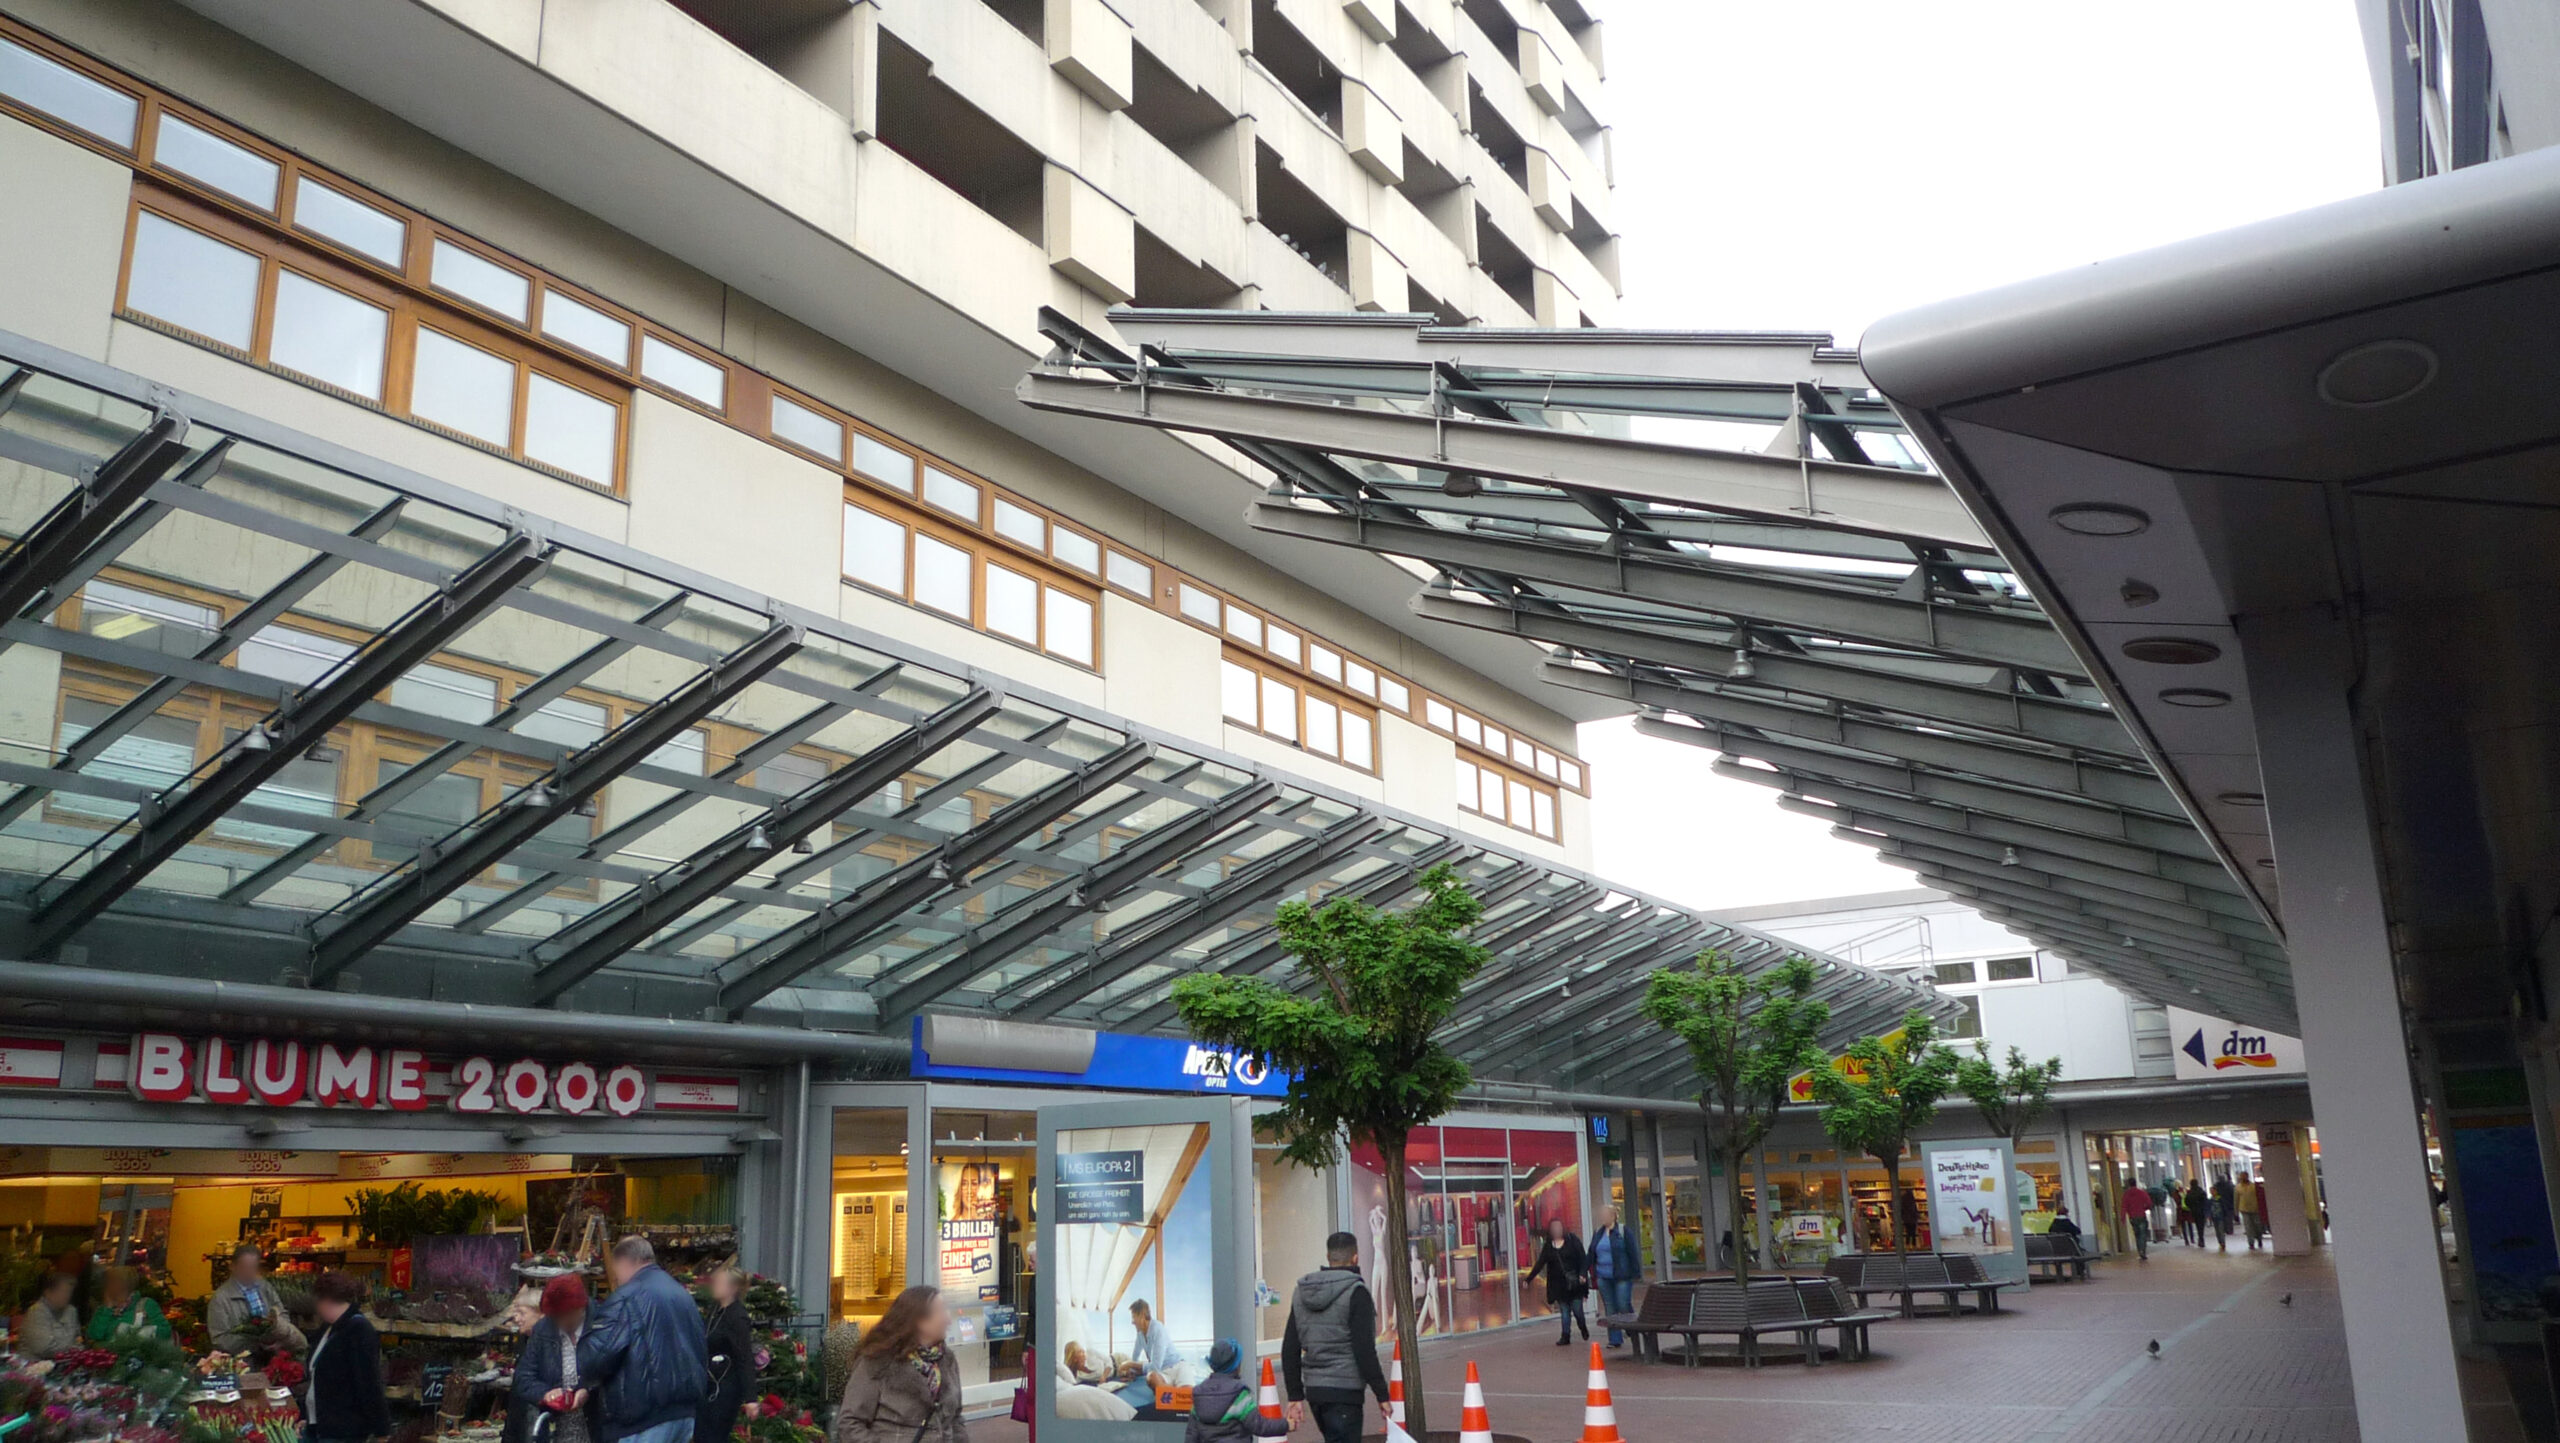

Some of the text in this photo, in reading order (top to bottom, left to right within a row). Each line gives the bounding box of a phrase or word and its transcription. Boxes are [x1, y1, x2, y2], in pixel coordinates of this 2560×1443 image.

[2221, 1029, 2266, 1056] dm
[138, 1034, 646, 1117] BLUME 2000
[1204, 1077, 1227, 1088] OPTIK
[2264, 1128, 2288, 1141] dm
[1068, 1160, 1132, 1174] MS EUROPA 2
[943, 1221, 994, 1238] 3 BRILLEN
[1798, 1218, 1819, 1231] dm
[943, 1252, 972, 1268] EINER
